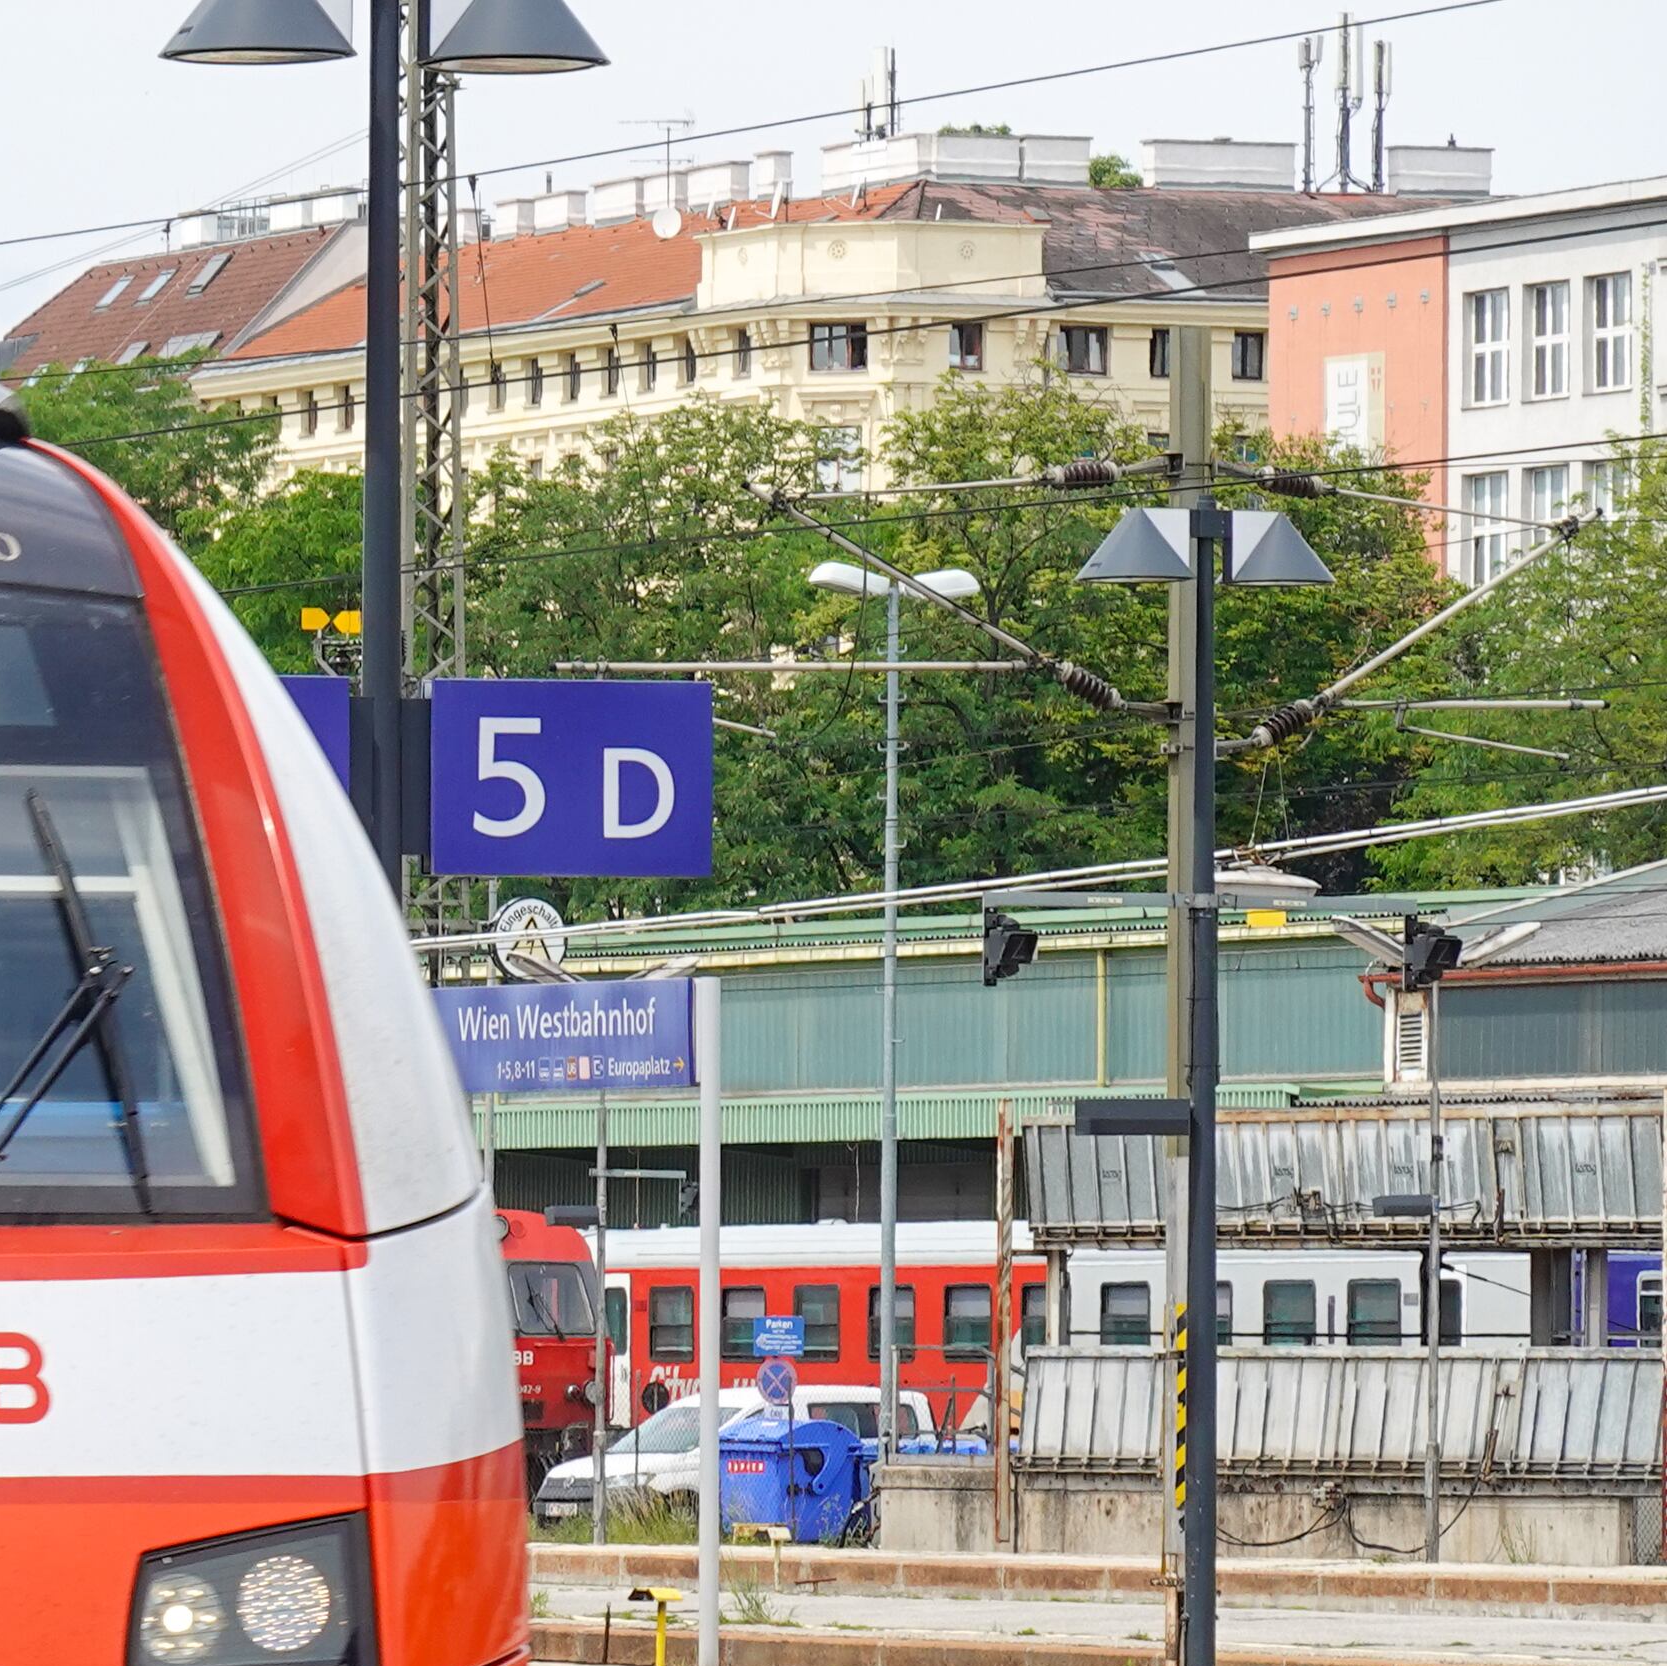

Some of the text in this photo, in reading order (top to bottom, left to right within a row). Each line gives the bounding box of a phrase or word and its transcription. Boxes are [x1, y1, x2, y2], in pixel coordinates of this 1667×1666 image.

[472, 716, 676, 839] 5 D
[458, 997, 656, 1042] Wien Westbahnhof
[608, 1056, 671, 1081] Europaplatz
